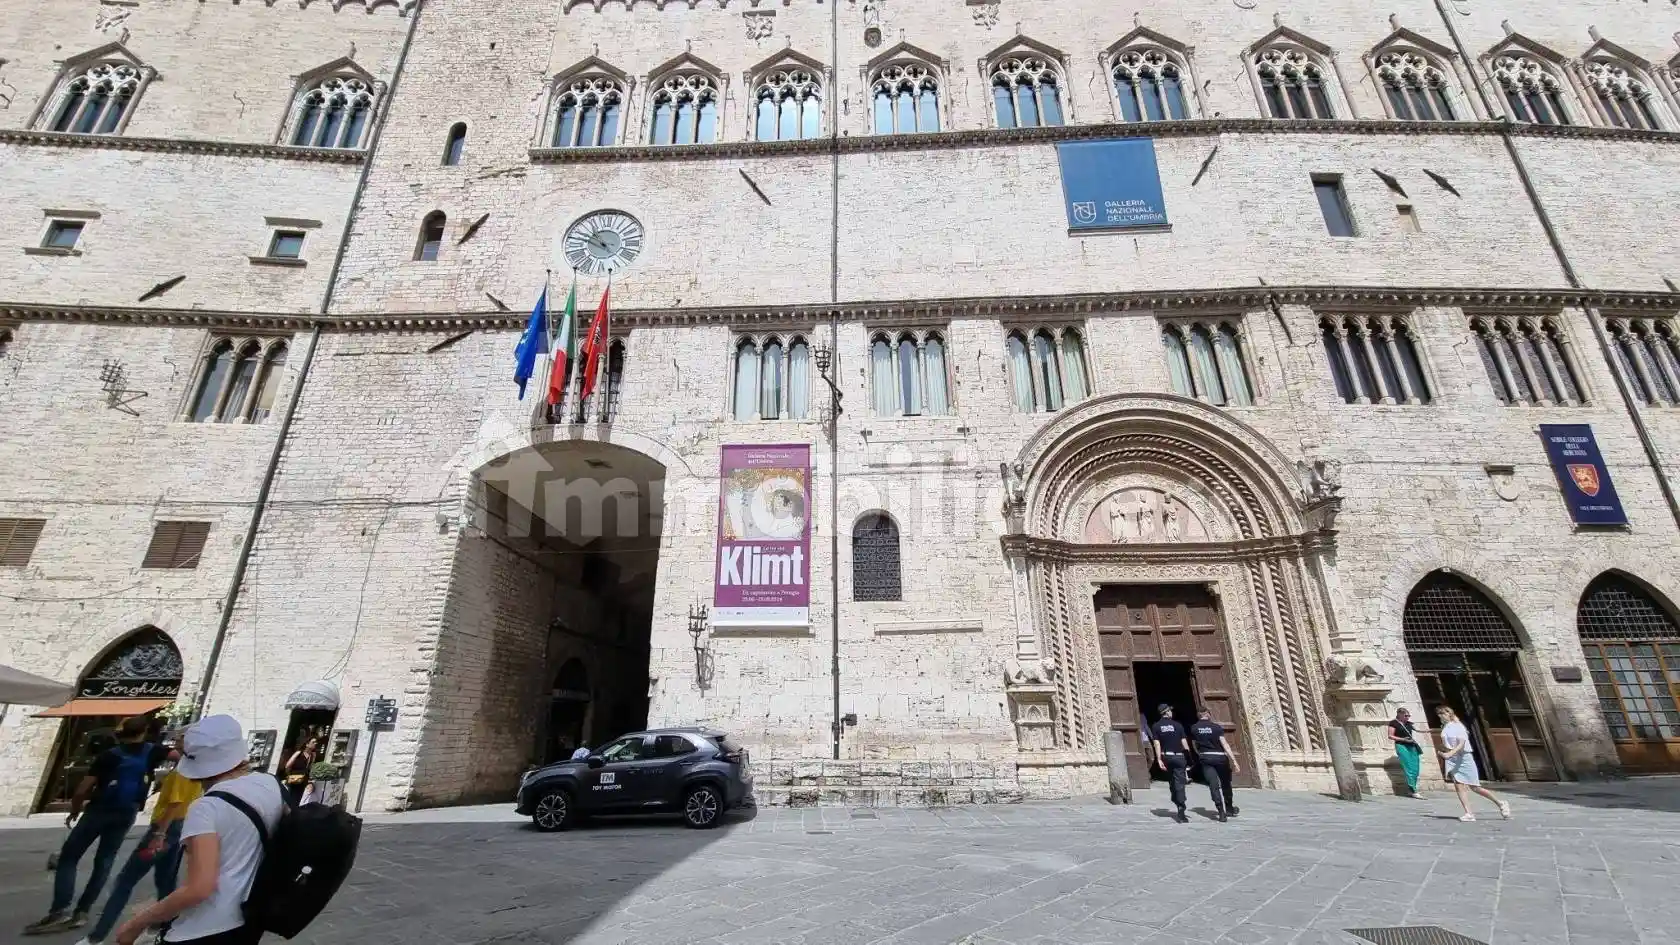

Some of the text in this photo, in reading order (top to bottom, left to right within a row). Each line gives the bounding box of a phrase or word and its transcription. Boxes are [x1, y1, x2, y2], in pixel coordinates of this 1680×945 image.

[1104, 199, 1146, 208] GALLERIA
[1106, 206, 1154, 214] NAZIONALE
[1107, 213, 1164, 222] DELL'UMBRIA
[720, 546, 804, 586] Klimt
